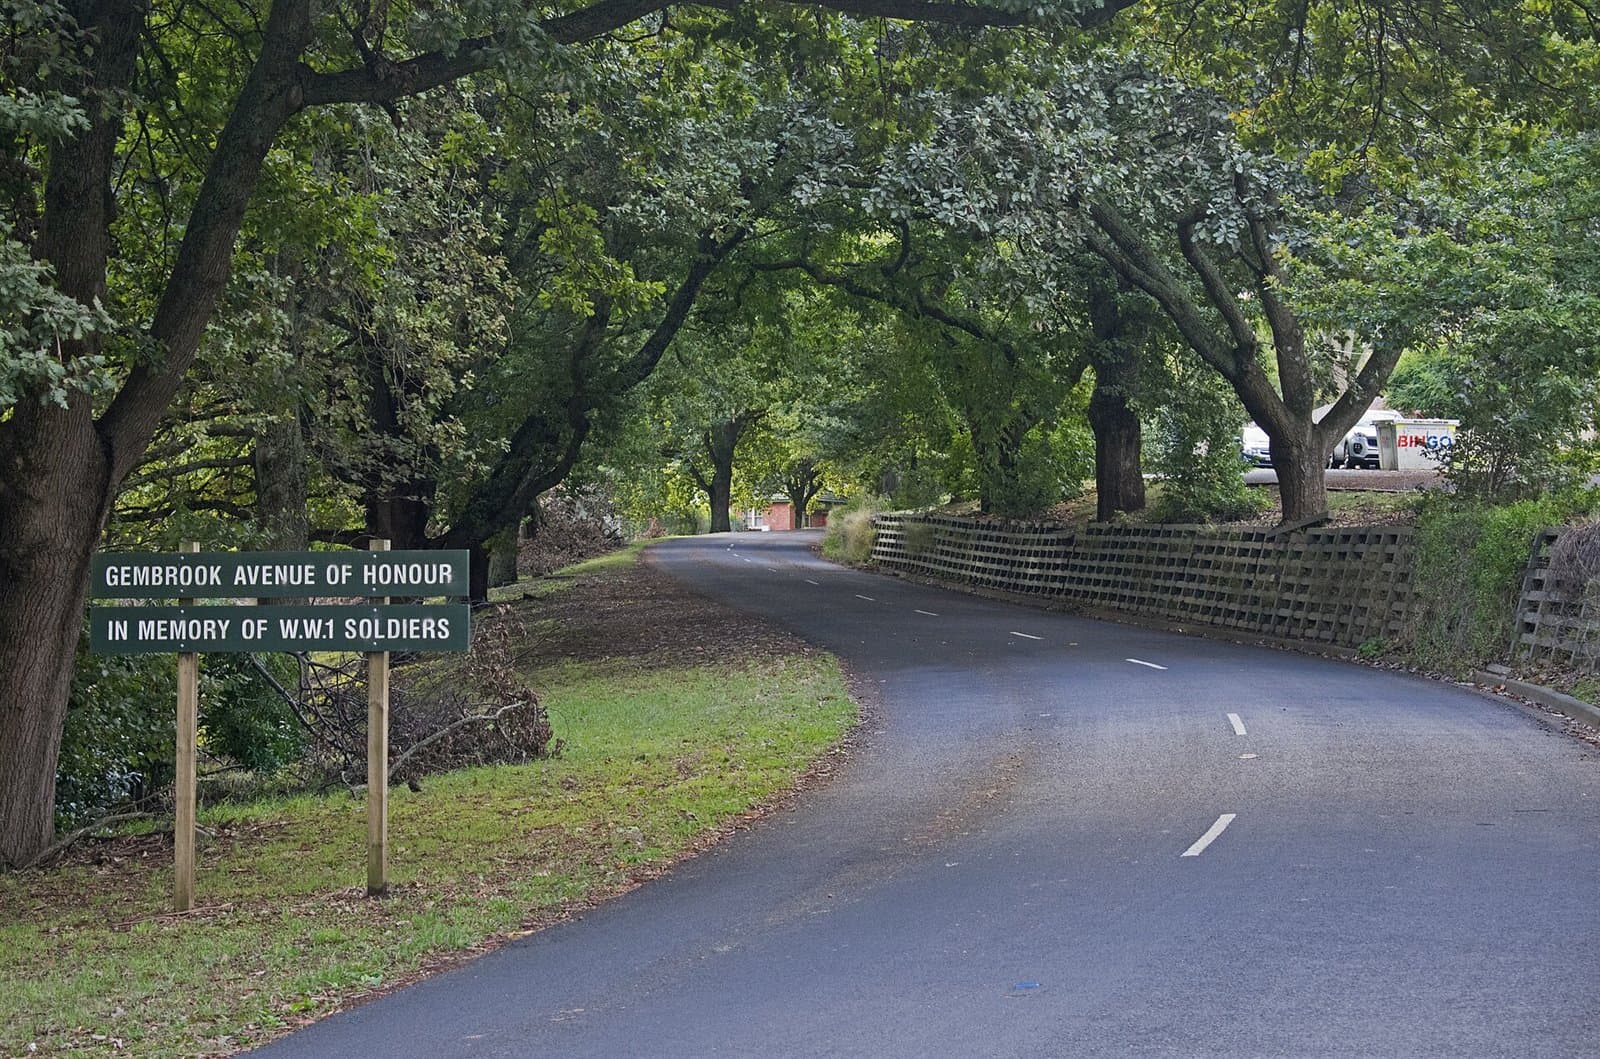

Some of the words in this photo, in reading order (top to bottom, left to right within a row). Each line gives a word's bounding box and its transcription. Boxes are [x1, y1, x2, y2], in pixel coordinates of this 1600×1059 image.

[105, 565, 222, 587] GEMBROOK
[233, 564, 316, 586] AVENUE
[326, 564, 353, 585] OF
[363, 563, 453, 585] HONOUR
[108, 620, 128, 641] IN
[138, 619, 230, 641] MEMORY
[241, 619, 268, 640] OF
[279, 618, 334, 640] W.W.1
[344, 618, 450, 640] SOLDIERS
